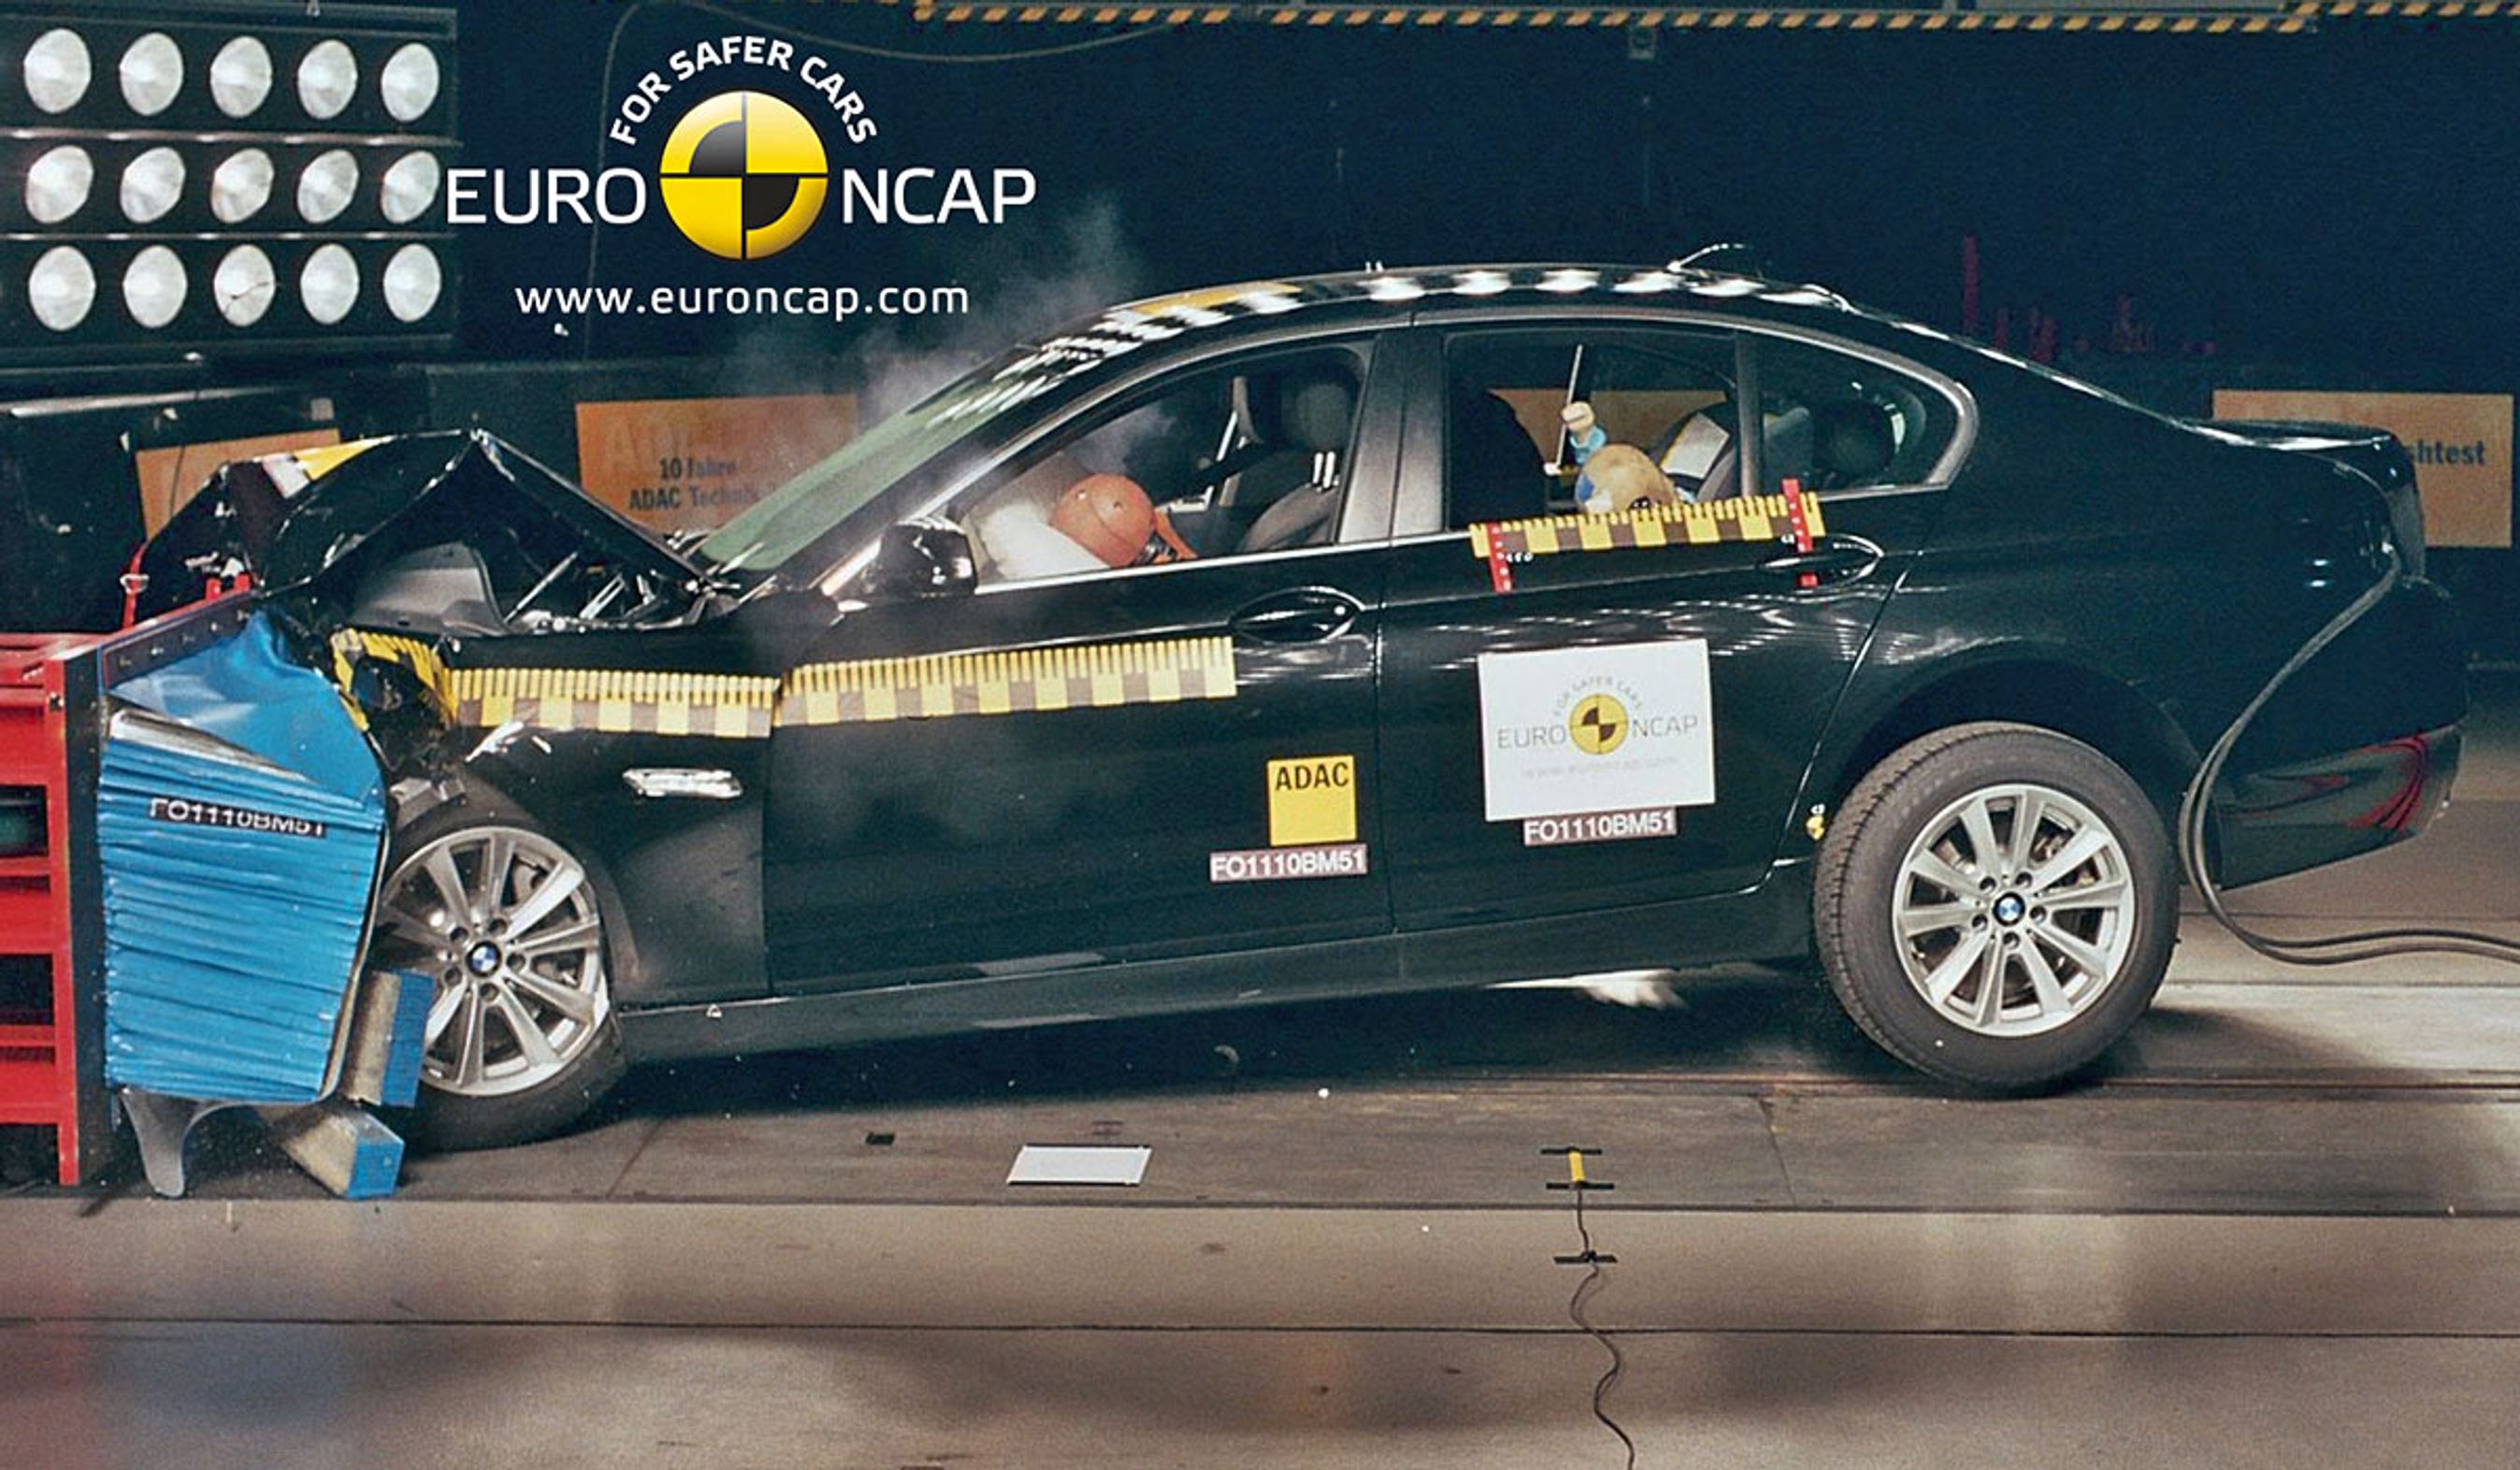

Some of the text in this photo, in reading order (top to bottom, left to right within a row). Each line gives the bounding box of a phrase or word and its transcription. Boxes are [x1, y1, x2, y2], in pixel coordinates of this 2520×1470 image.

[659, 457, 682, 480] 10
[628, 486, 681, 512] ADAC
[1497, 714, 1698, 749] EURO NCAP
[1274, 761, 1349, 791] ADAC
[1524, 811, 1676, 843] FO1110BM51
[1210, 850, 1363, 881] FO1110BM51
